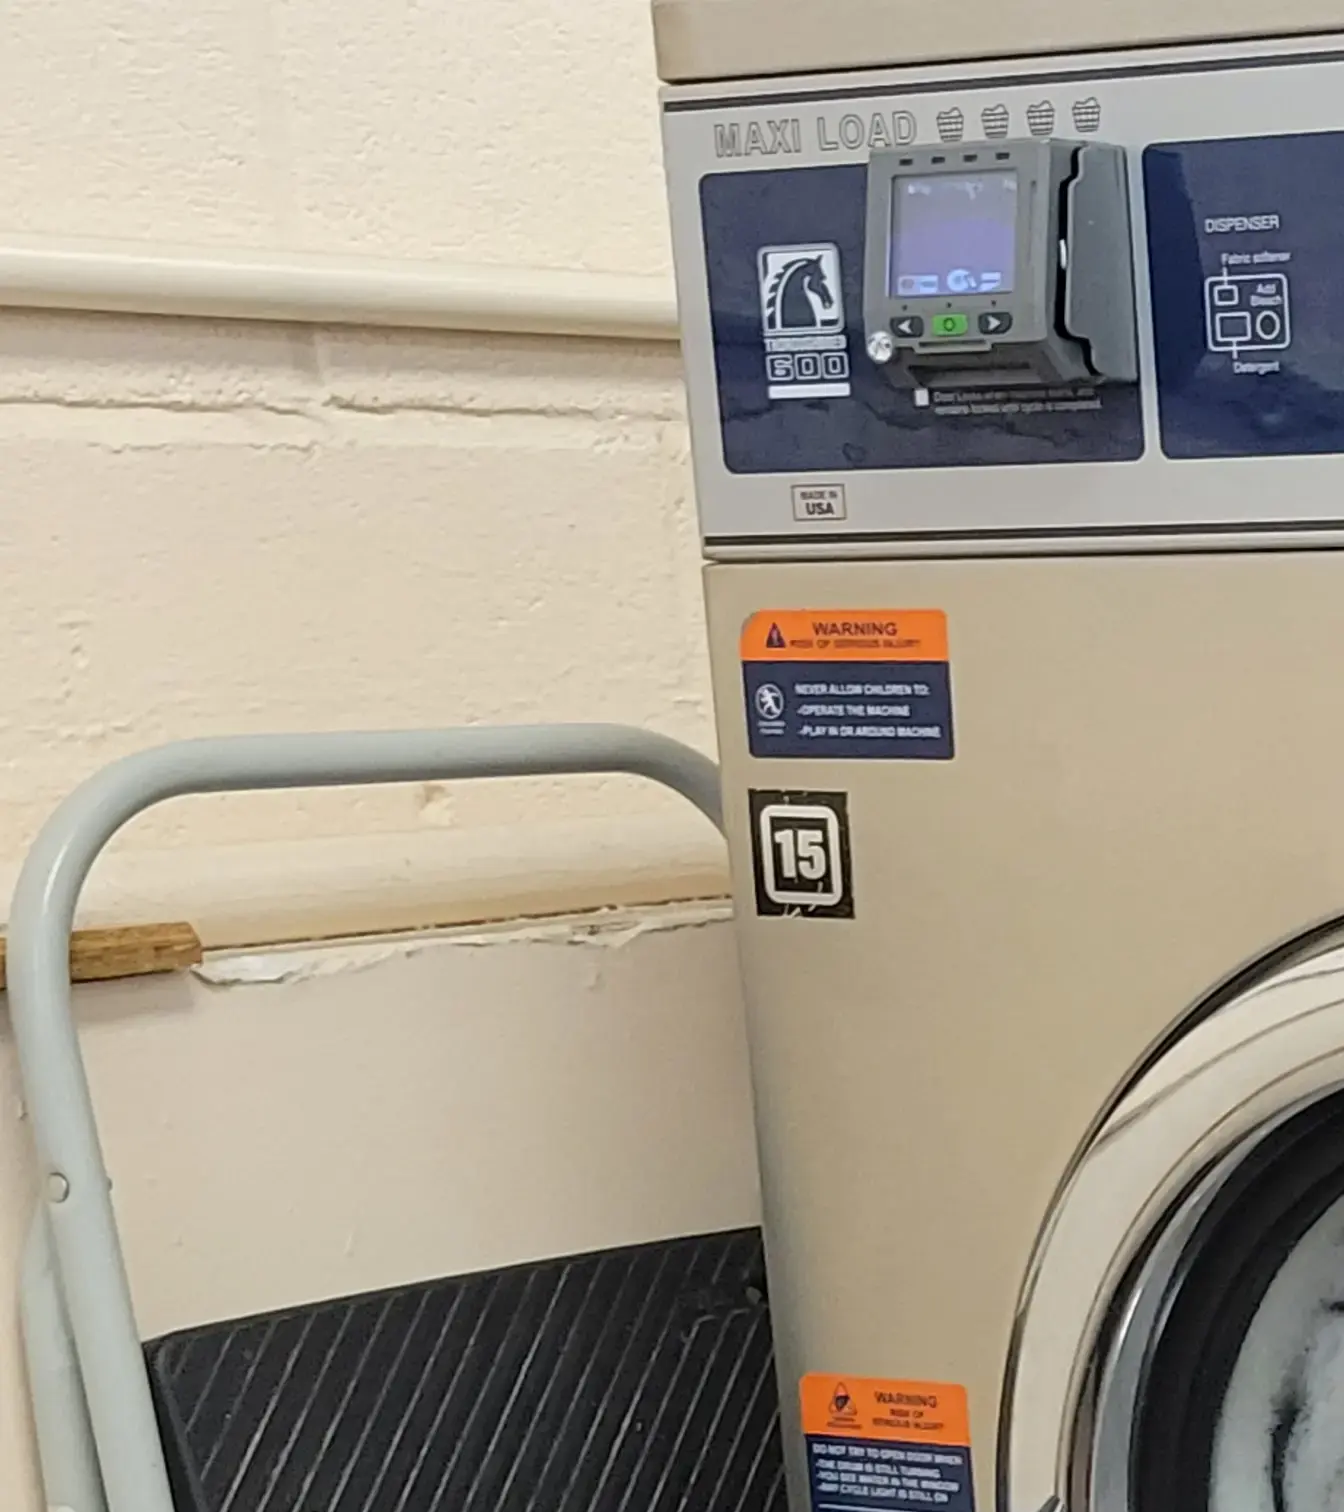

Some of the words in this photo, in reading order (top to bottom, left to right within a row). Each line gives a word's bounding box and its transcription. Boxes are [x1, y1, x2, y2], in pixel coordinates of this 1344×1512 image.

[713, 118, 803, 158] MAXI
[816, 110, 918, 152] LOAD
[1204, 214, 1280, 234] DISPENSER
[765, 351, 849, 382] 600
[805, 501, 836, 516] USA
[812, 621, 898, 637] WARNING
[774, 828, 827, 880] 15
